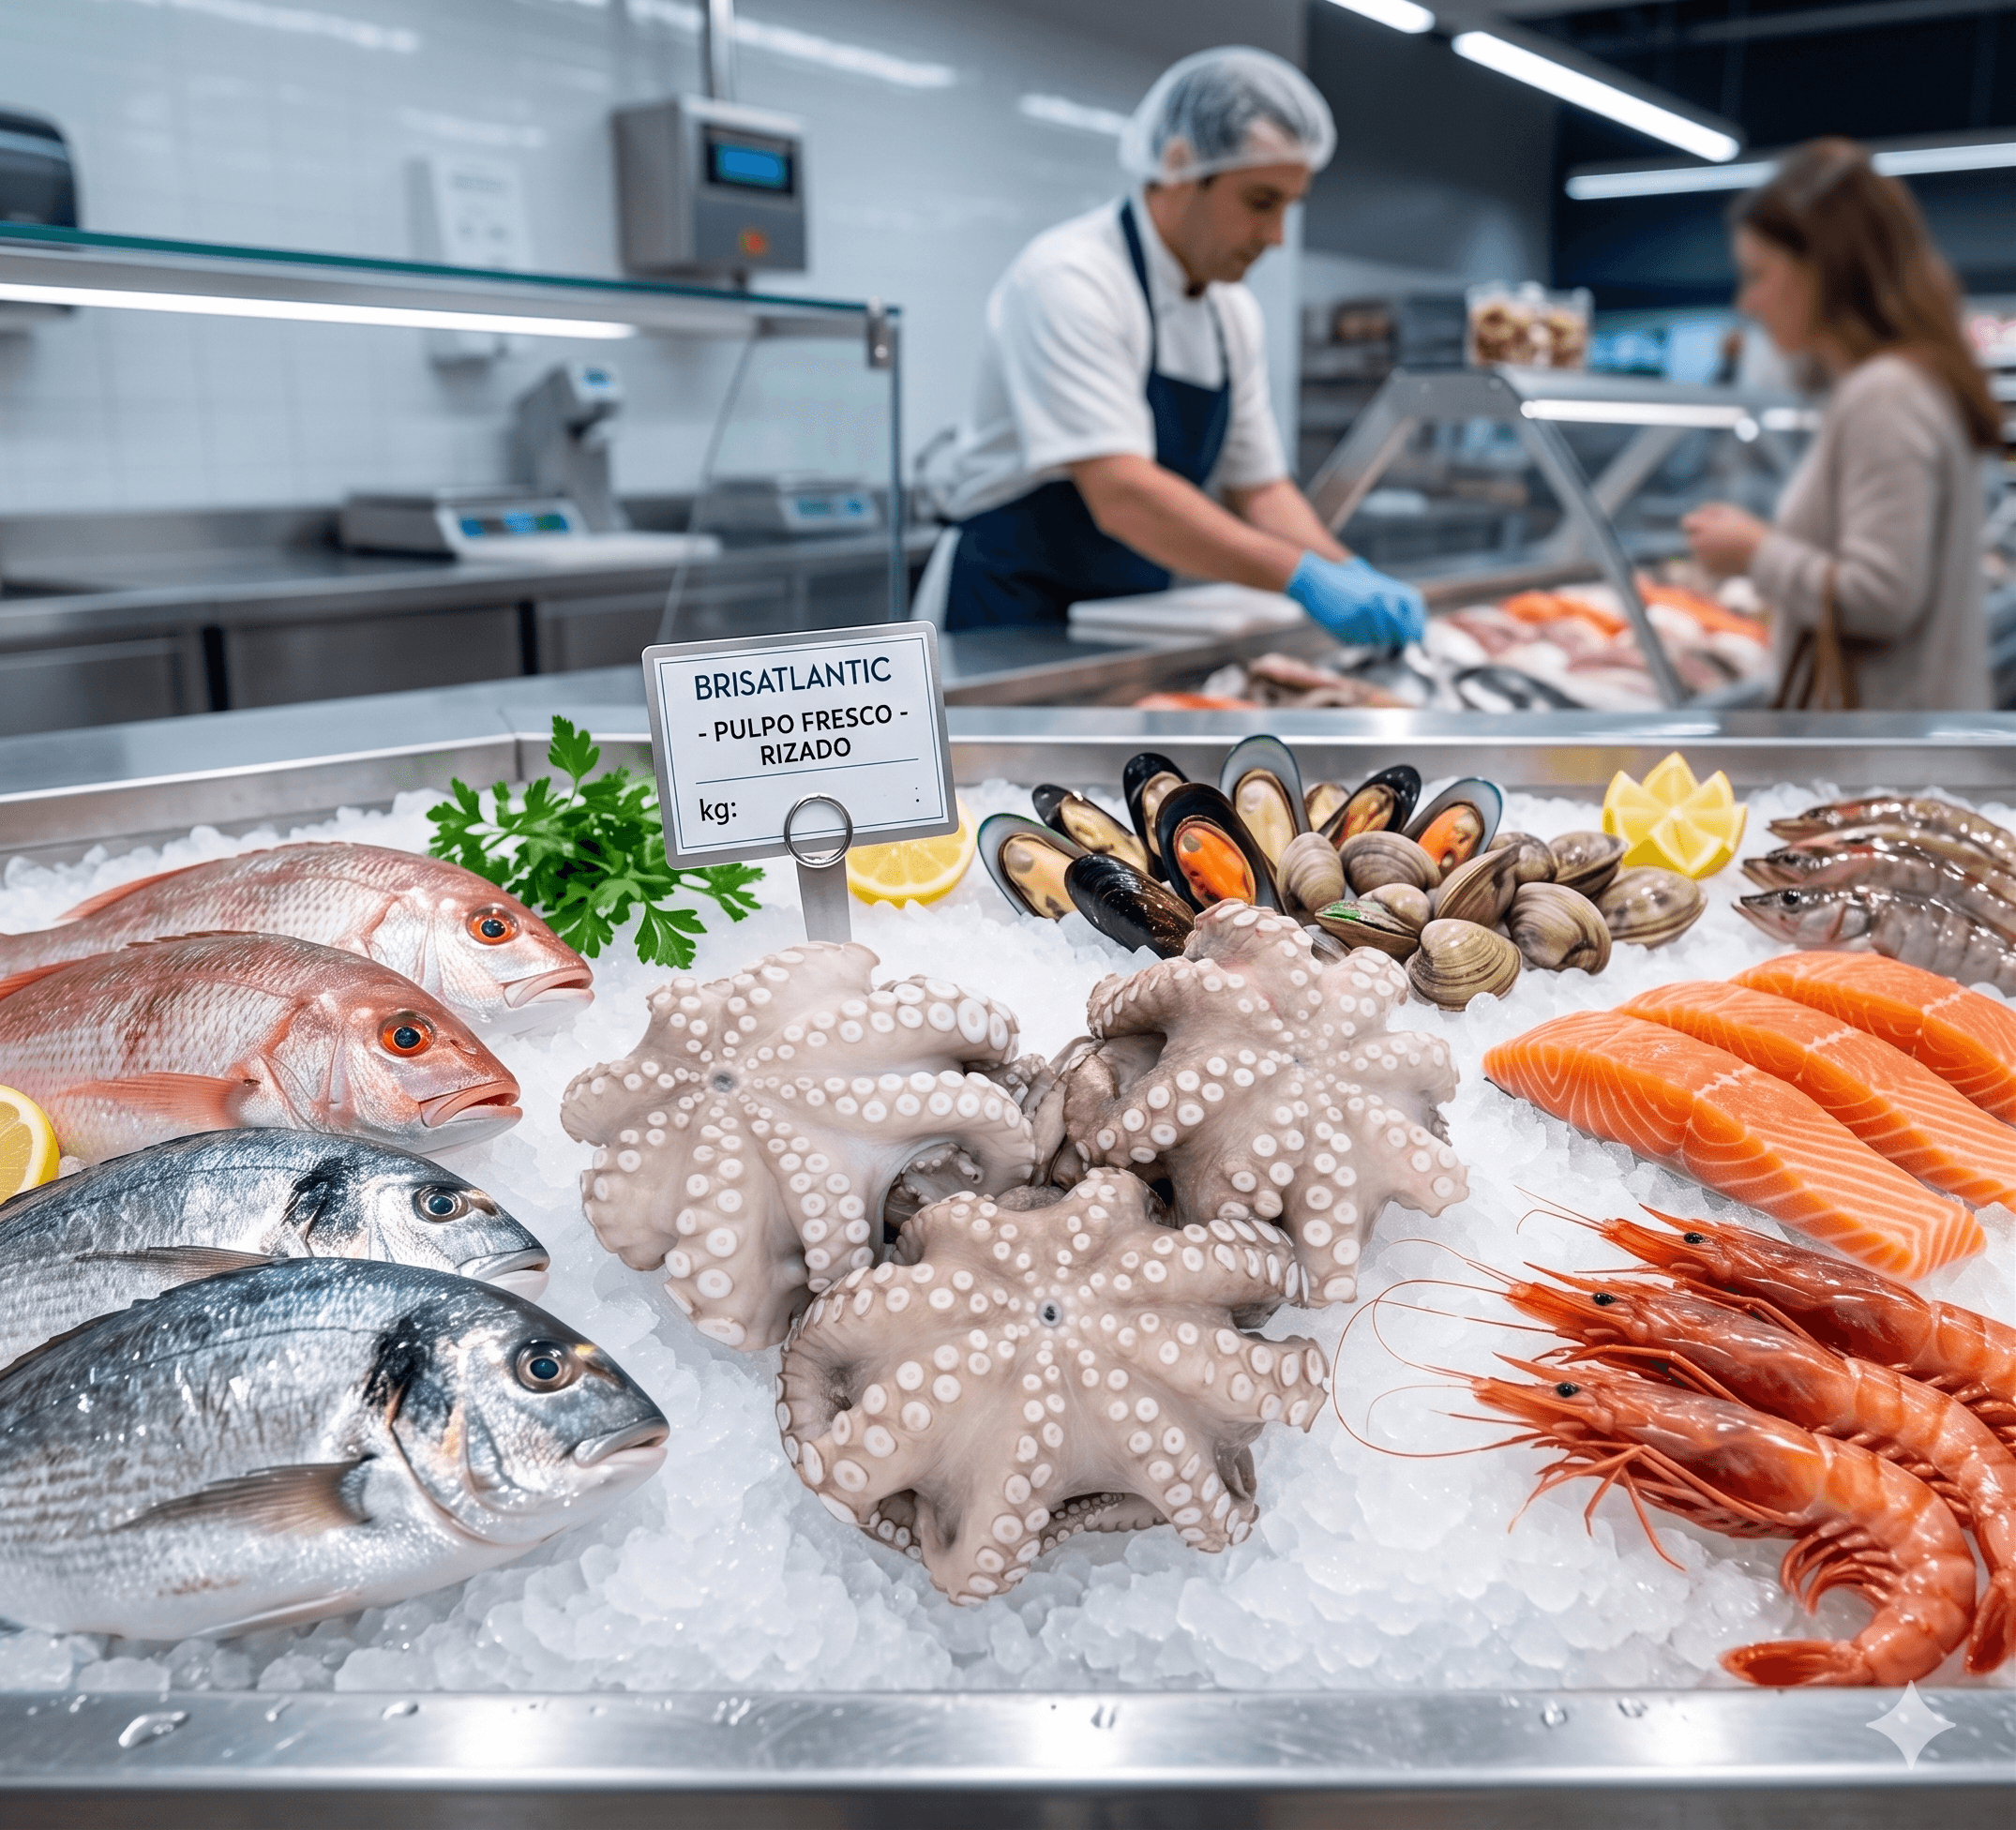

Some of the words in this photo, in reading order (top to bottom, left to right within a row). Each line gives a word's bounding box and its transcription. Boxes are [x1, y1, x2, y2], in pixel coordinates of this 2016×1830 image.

[694, 657, 892, 700] BRISATLANTIC
[714, 713, 795, 742] PULPO
[801, 704, 892, 732] FRESCO
[760, 737, 851, 766] RIZADO
[699, 798, 737, 826] kg:
